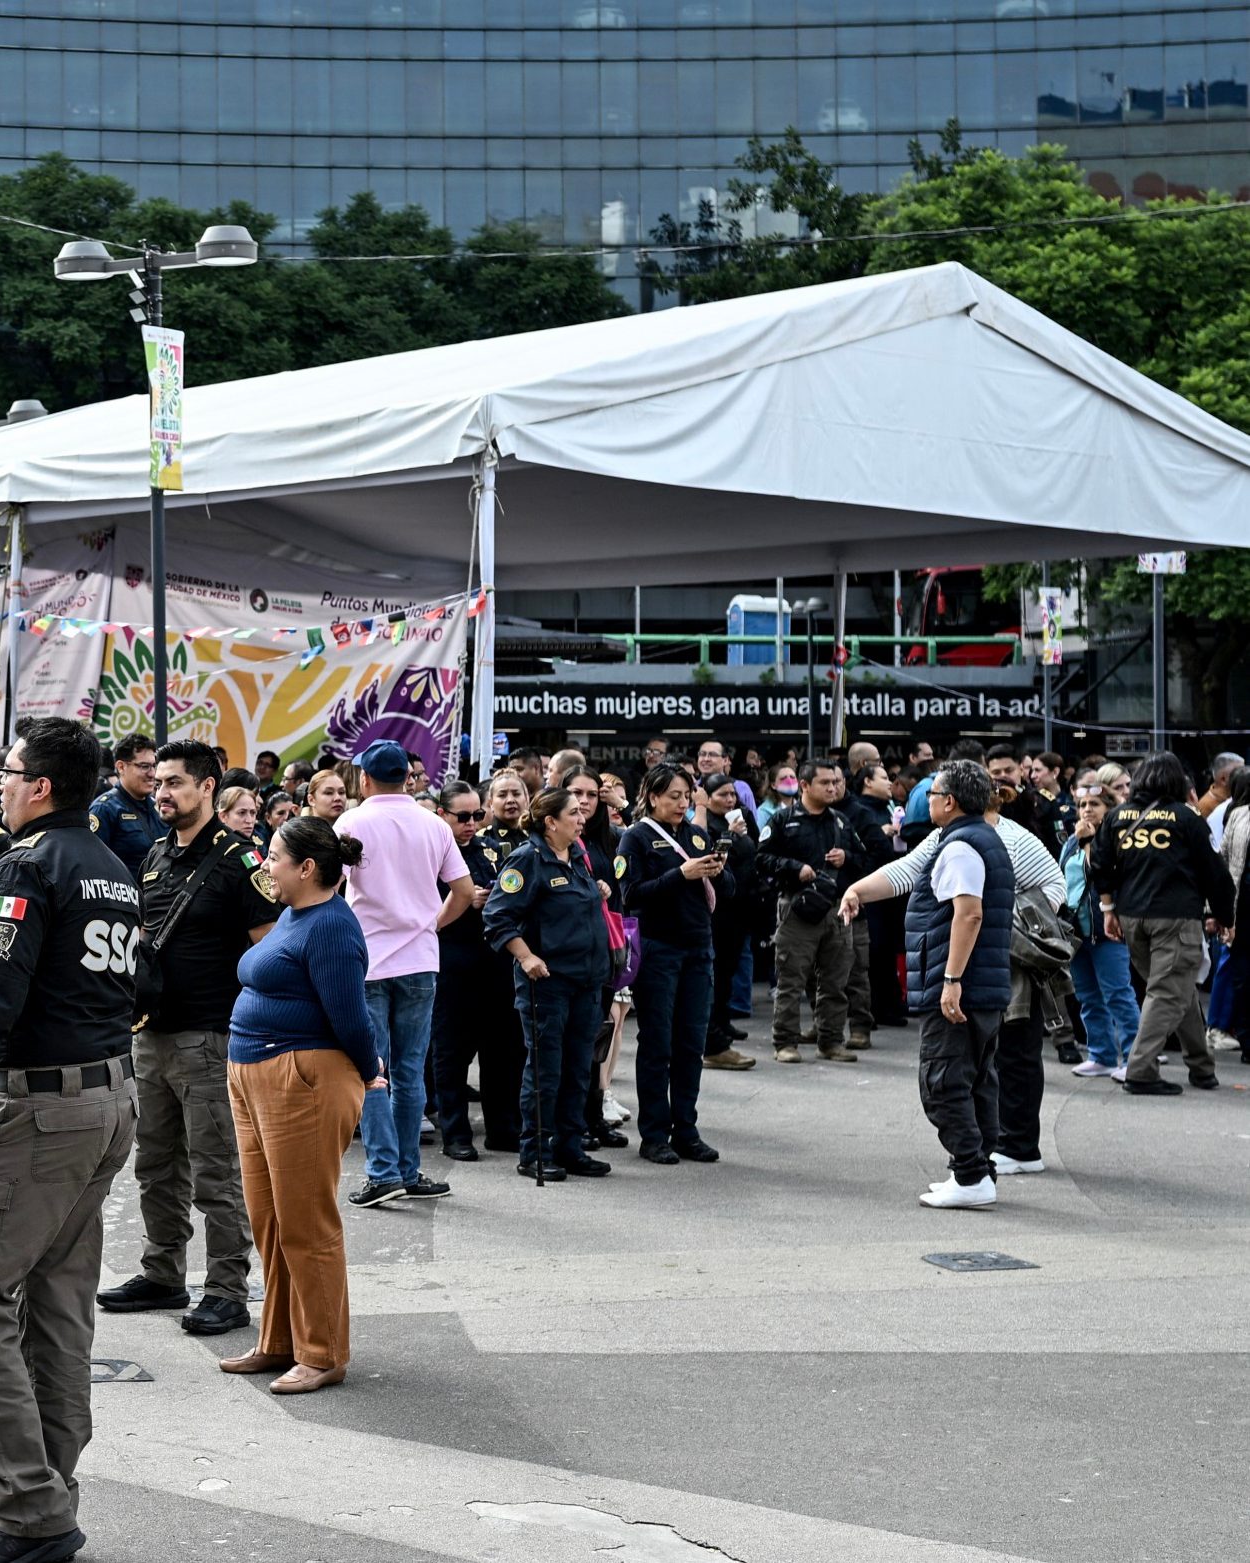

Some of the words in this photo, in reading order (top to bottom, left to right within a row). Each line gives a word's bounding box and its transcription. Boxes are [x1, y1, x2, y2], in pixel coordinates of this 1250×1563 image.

[165, 572, 213, 587] GOBIERNO
[215, 581, 226, 589] DE
[229, 584, 240, 592] LA
[165, 582, 194, 595] CIUDAD
[196, 589, 208, 597] DE
[210, 591, 241, 602] MÉXICO
[320, 590, 368, 612] Puntos
[494, 691, 587, 715] muchas
[701, 696, 760, 720] gana
[767, 696, 810, 716] una
[913, 696, 971, 721] para
[979, 692, 1001, 717] la
[1118, 828, 1171, 850] SSC
[80, 919, 140, 976] SSC
